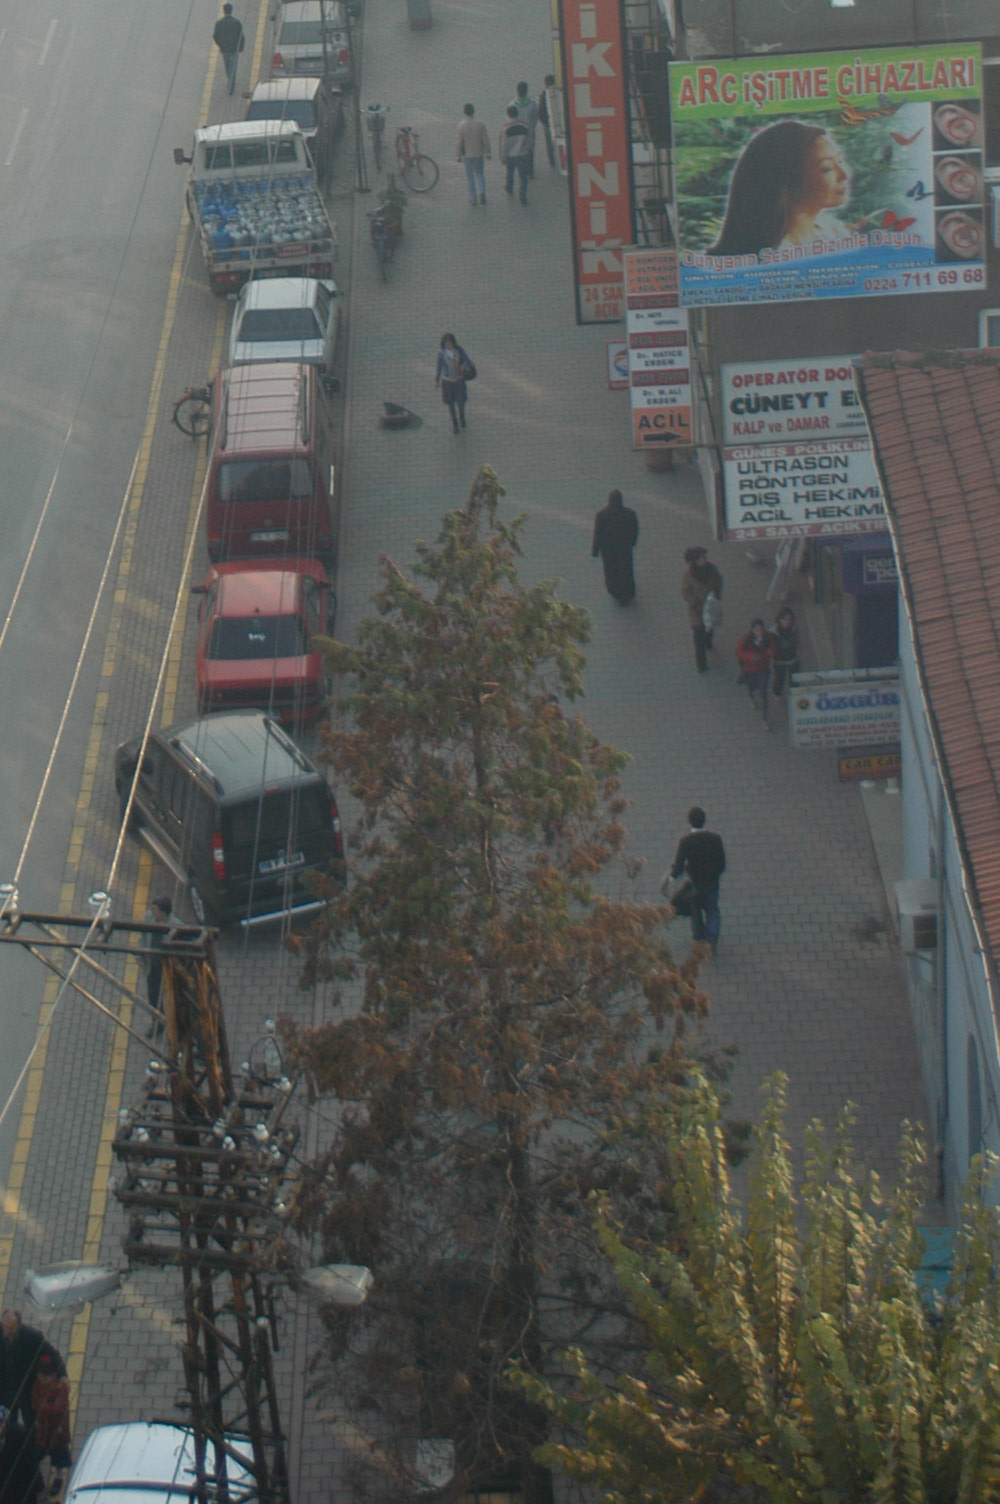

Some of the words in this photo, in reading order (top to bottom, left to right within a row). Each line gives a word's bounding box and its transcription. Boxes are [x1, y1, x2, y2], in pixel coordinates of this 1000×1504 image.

[837, 58, 976, 97] CİHAZLARI
[864, 277, 897, 291] 0224
[903, 271, 932, 288] 711
[938, 268, 958, 285] 69
[963, 267, 984, 284] 68
[584, 288, 600, 302] 24
[732, 369, 819, 388] OPERATÖR
[730, 391, 829, 415] CÜNEYT
[638, 409, 690, 429] ACİL
[733, 419, 769, 436] KALP
[768, 422, 782, 433] ve
[787, 415, 830, 432] DAMAR
[732, 446, 788, 459] GÜNEŞ
[737, 455, 849, 475] ULTRASON
[739, 473, 848, 491] RÖNTGEN
[735, 529, 757, 539] 24
[765, 525, 812, 536] SAAT
[816, 688, 900, 711] ÖZGÜR
